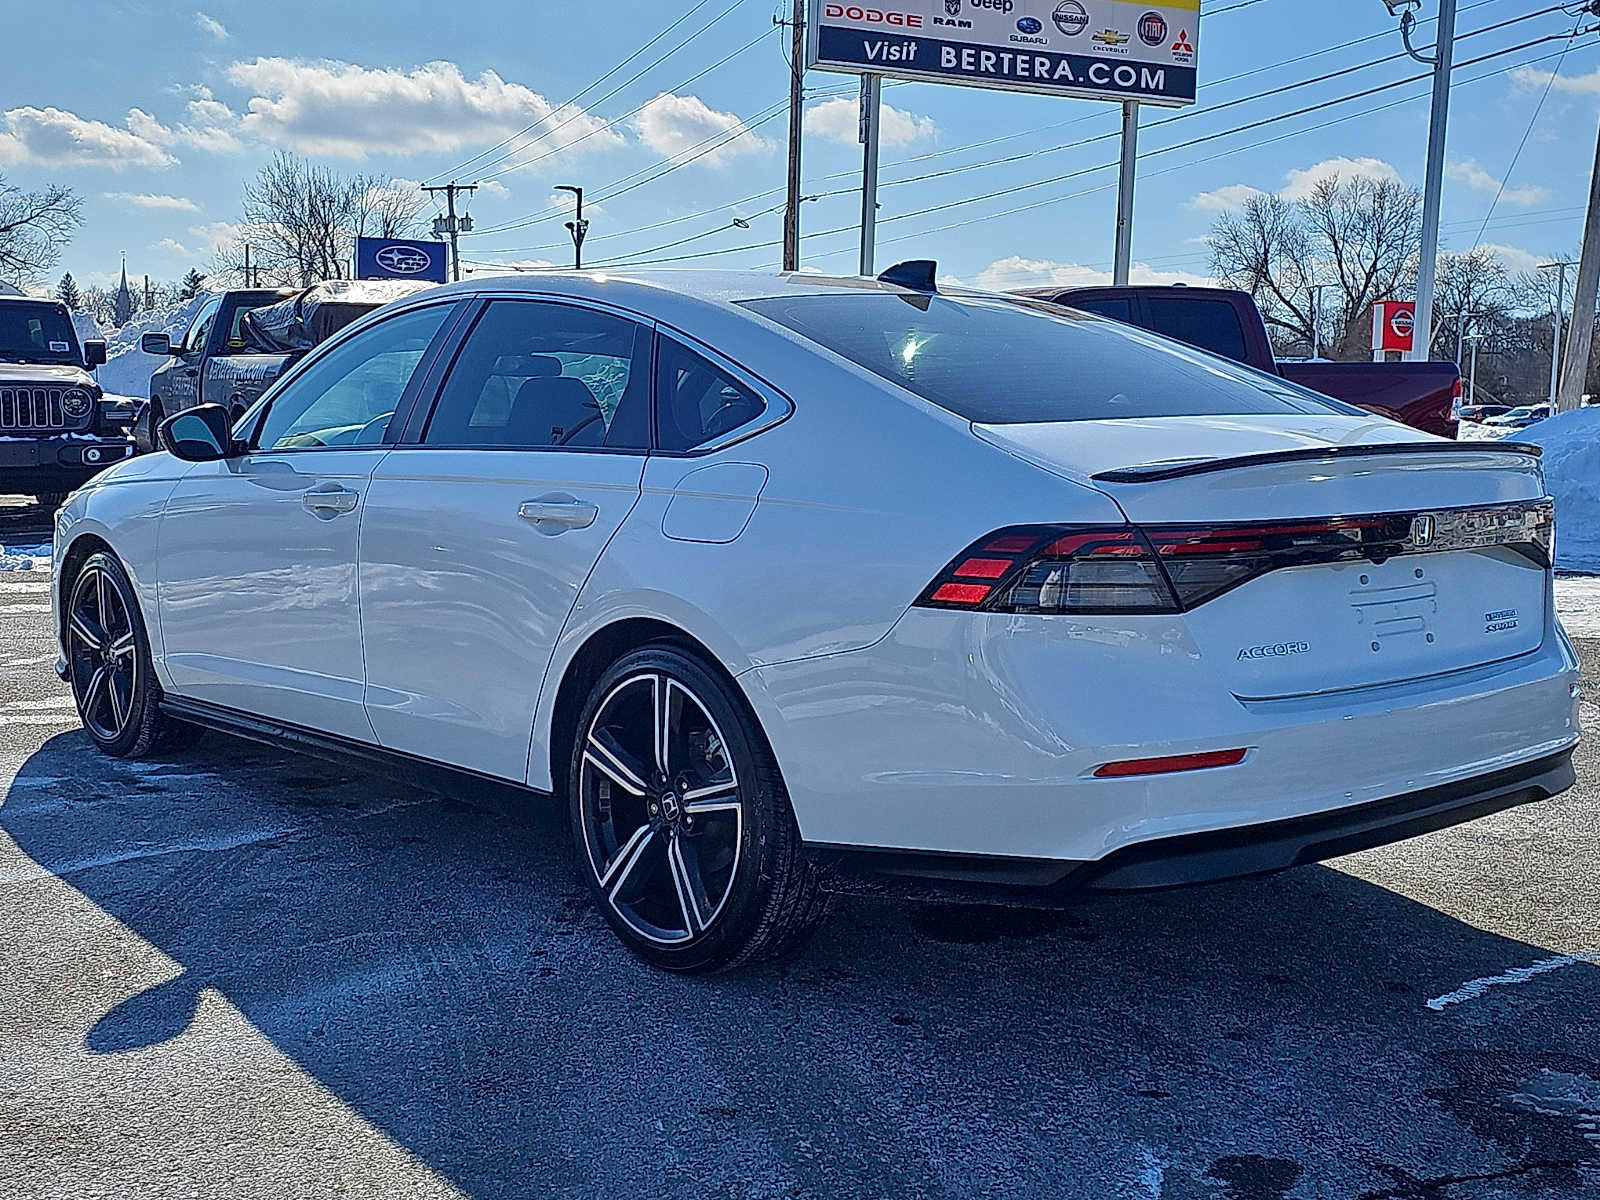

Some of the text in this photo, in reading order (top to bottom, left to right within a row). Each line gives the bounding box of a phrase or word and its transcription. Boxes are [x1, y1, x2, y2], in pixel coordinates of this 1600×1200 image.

[825, 4, 923, 28] DODGE
[933, 16, 972, 29] RAM
[1055, 13, 1086, 22] NISSAN
[1145, 21, 1162, 38] FIAT
[1009, 34, 1048, 45] SUBARU
[1092, 45, 1129, 54] CHEVROLET
[864, 40, 1165, 90] Visit BERTERA.COM
[1236, 641, 1311, 661] ACCORD
